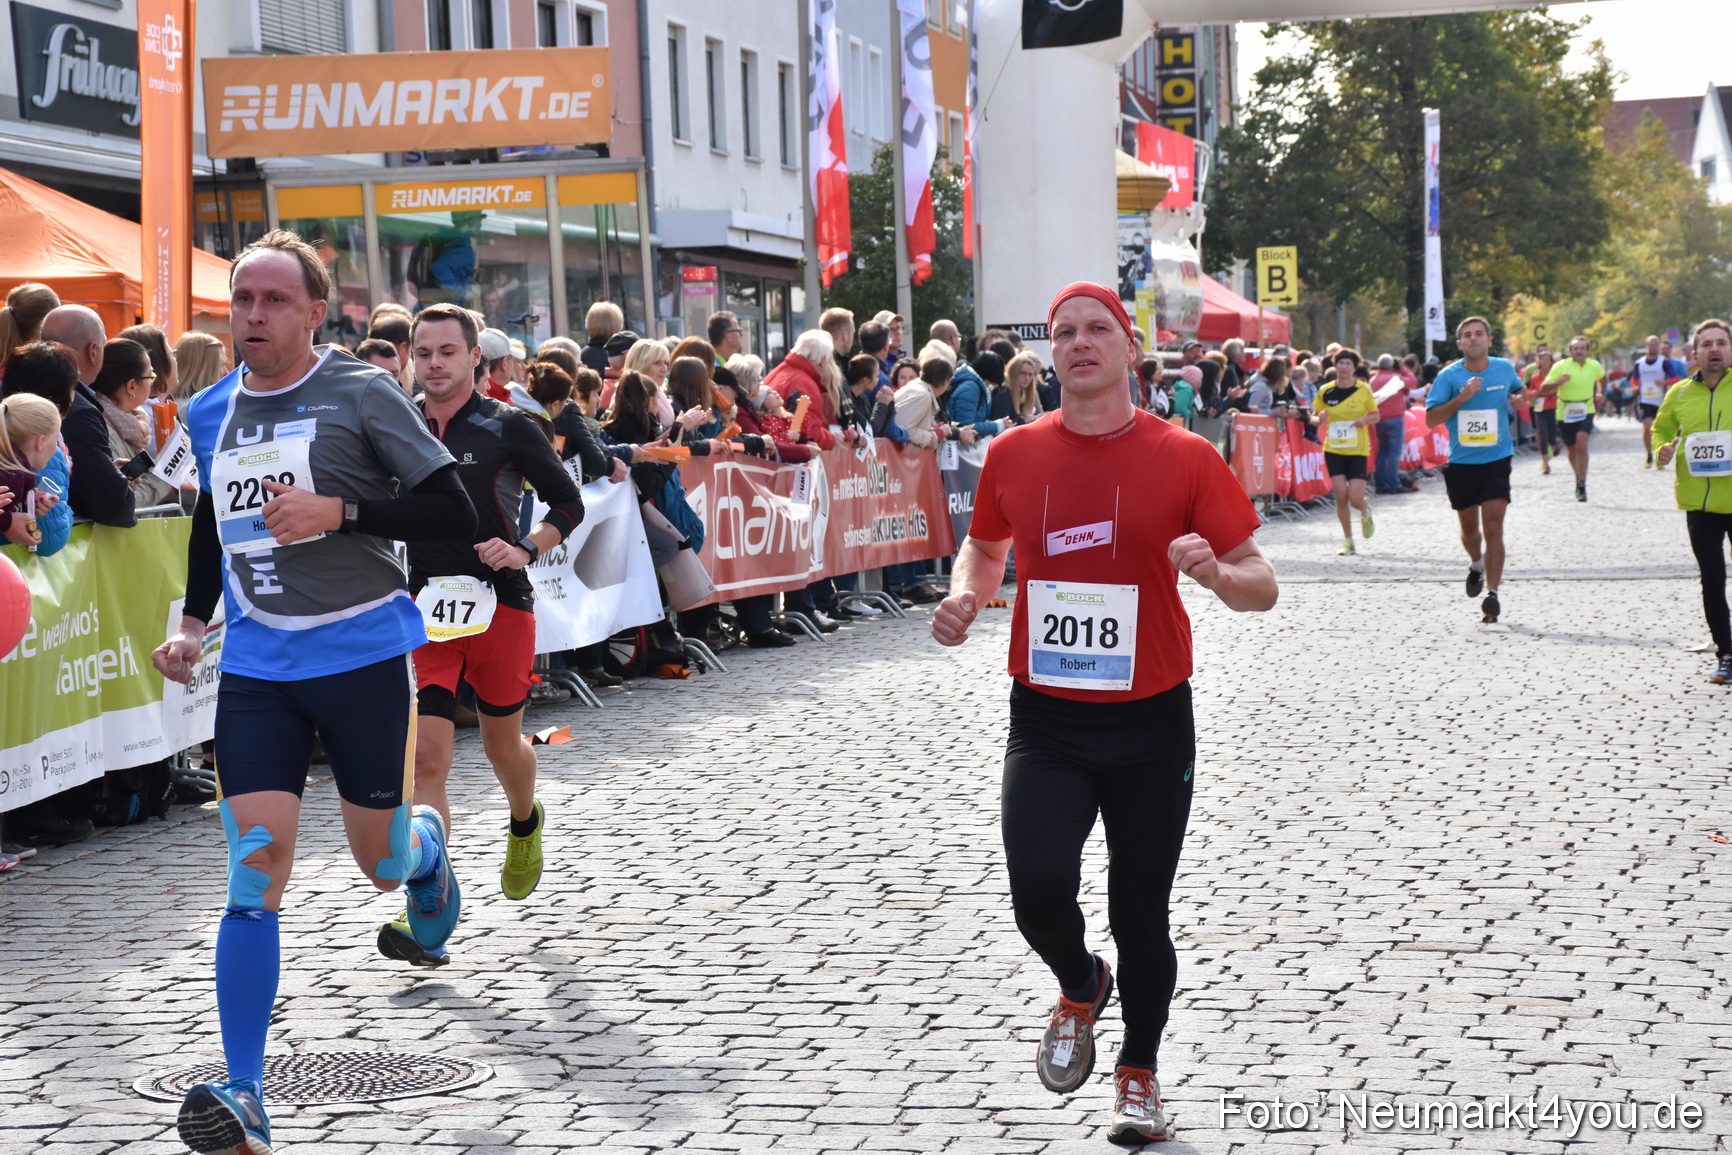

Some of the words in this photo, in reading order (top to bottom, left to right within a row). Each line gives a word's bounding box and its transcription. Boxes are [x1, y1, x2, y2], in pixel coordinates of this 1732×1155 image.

[219, 75, 592, 132] RUNMARKT.DE
[392, 184, 533, 209] RUNMARKT.DE
[1261, 249, 1293, 261] Block
[1268, 265, 1288, 293] B
[1533, 324, 1546, 341] C
[1337, 429, 1347, 438] 51
[1467, 421, 1488, 433] 254
[248, 450, 280, 465] BOCK
[1692, 445, 1725, 459] 2375
[163, 446, 187, 478] swn
[569, 458, 580, 482] swn
[907, 504, 928, 539] Hits
[1064, 530, 1095, 546] DEHN
[446, 583, 474, 591] BOCK
[1066, 592, 1105, 604] BOCK
[431, 598, 477, 625] 417
[42, 612, 70, 651] weiß
[1043, 613, 1119, 649] 2018
[1060, 657, 1097, 671] Robert
